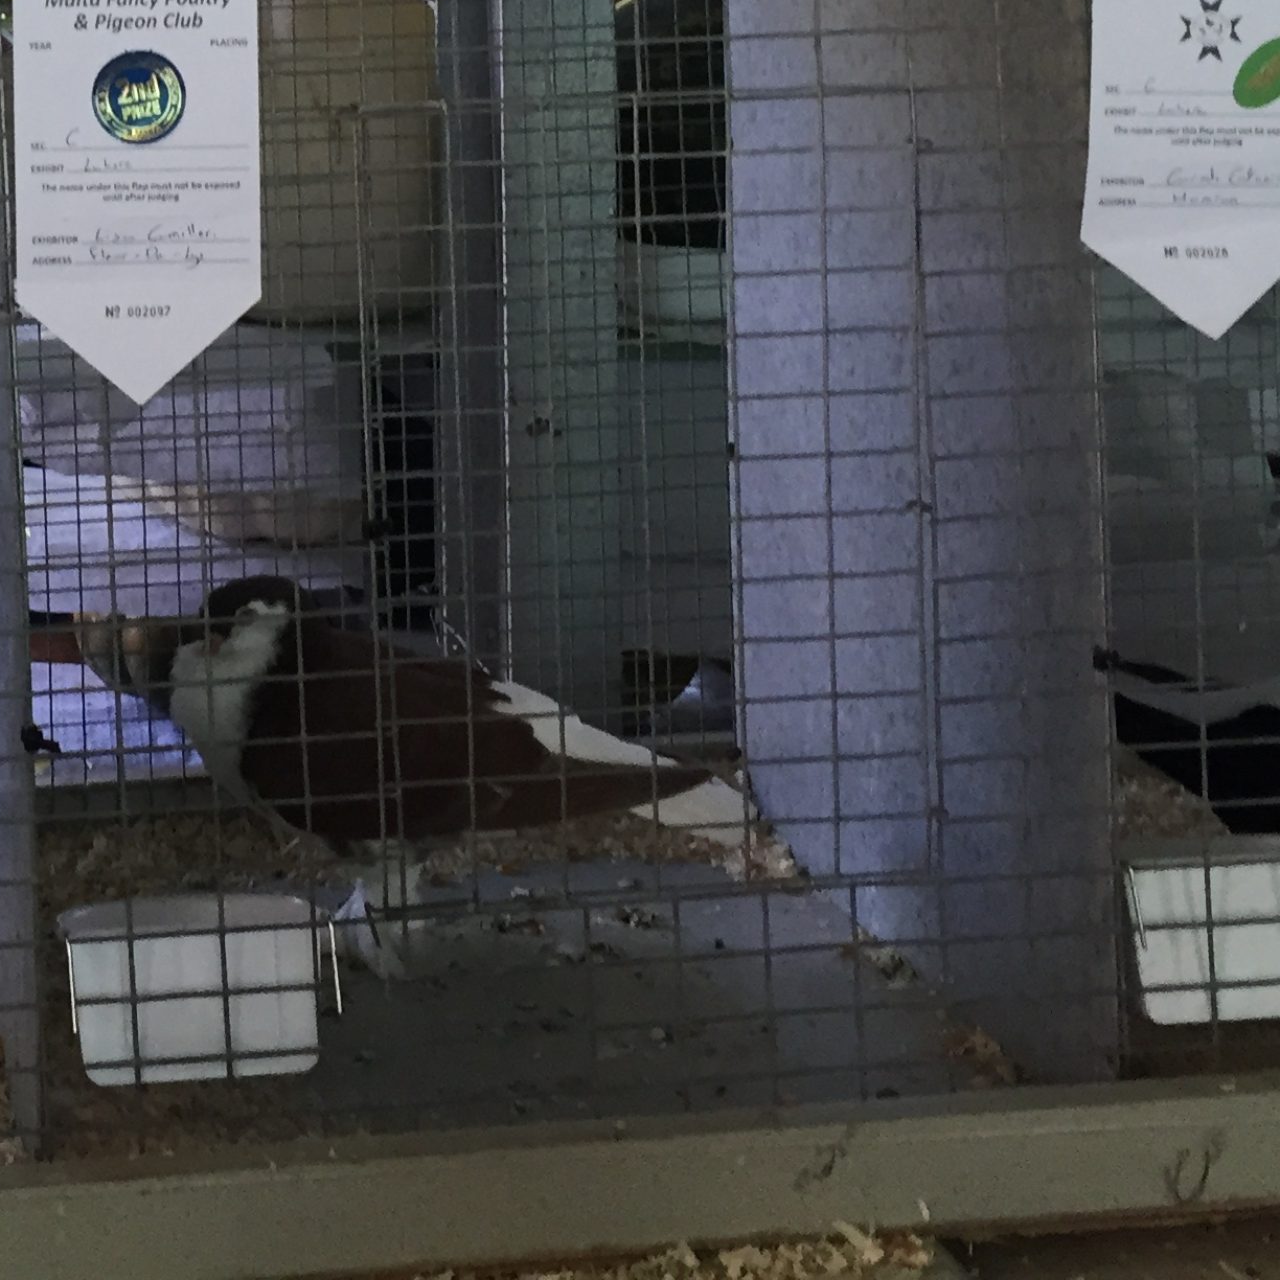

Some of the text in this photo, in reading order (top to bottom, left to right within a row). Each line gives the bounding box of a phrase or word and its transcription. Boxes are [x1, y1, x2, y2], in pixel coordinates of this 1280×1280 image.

[74, 11, 203, 33] & Pigeon Club
[29, 42, 52, 51] YEAR
[210, 38, 248, 48] PLACING
